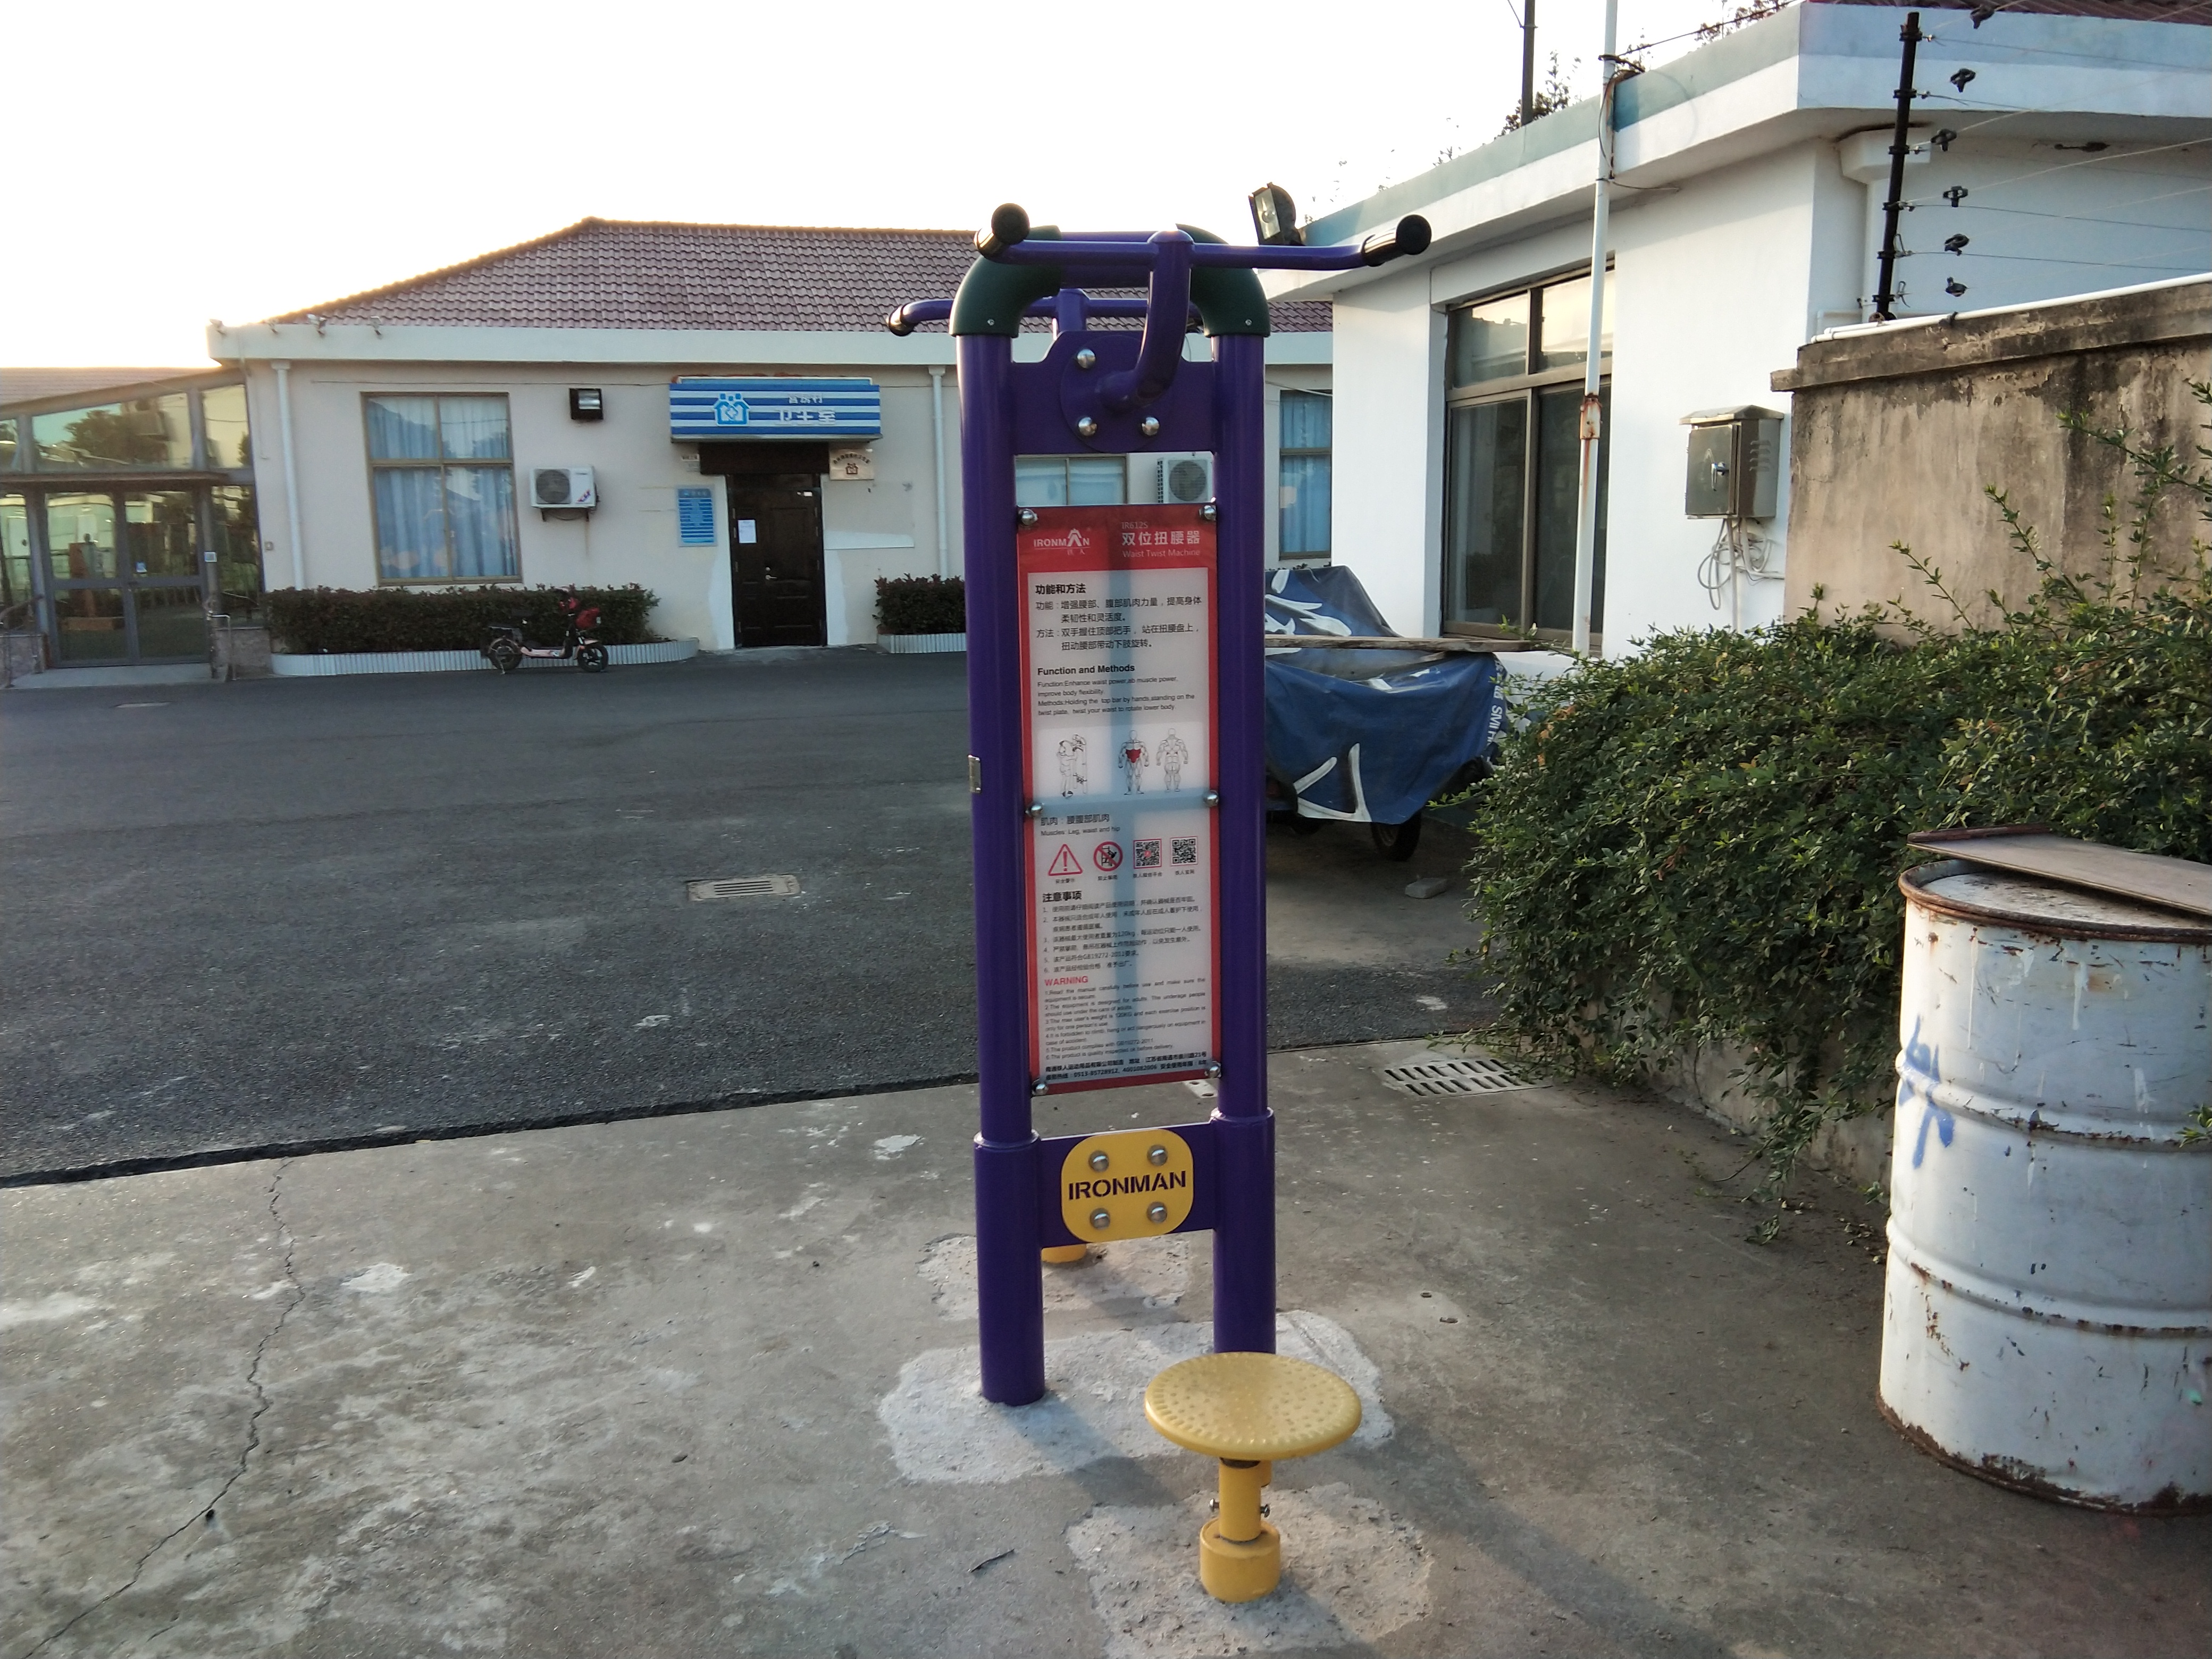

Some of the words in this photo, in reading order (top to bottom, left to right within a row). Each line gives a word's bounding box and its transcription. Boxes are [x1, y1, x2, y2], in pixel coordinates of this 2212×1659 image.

[1034, 528, 1090, 547] IRONMAN
[1121, 531, 1201, 546] 双位扭腰器
[1122, 549, 1145, 558] Waist
[1168, 548, 1201, 557] Machine
[1035, 583, 1086, 595] 功能和方法
[1037, 666, 1077, 676] Function
[1078, 665, 1095, 674] and
[1097, 664, 1135, 673] Methods
[1042, 890, 1082, 903] 注意事项
[1044, 975, 1088, 986] WARNING
[1069, 1170, 1186, 1201] IRONMAN
